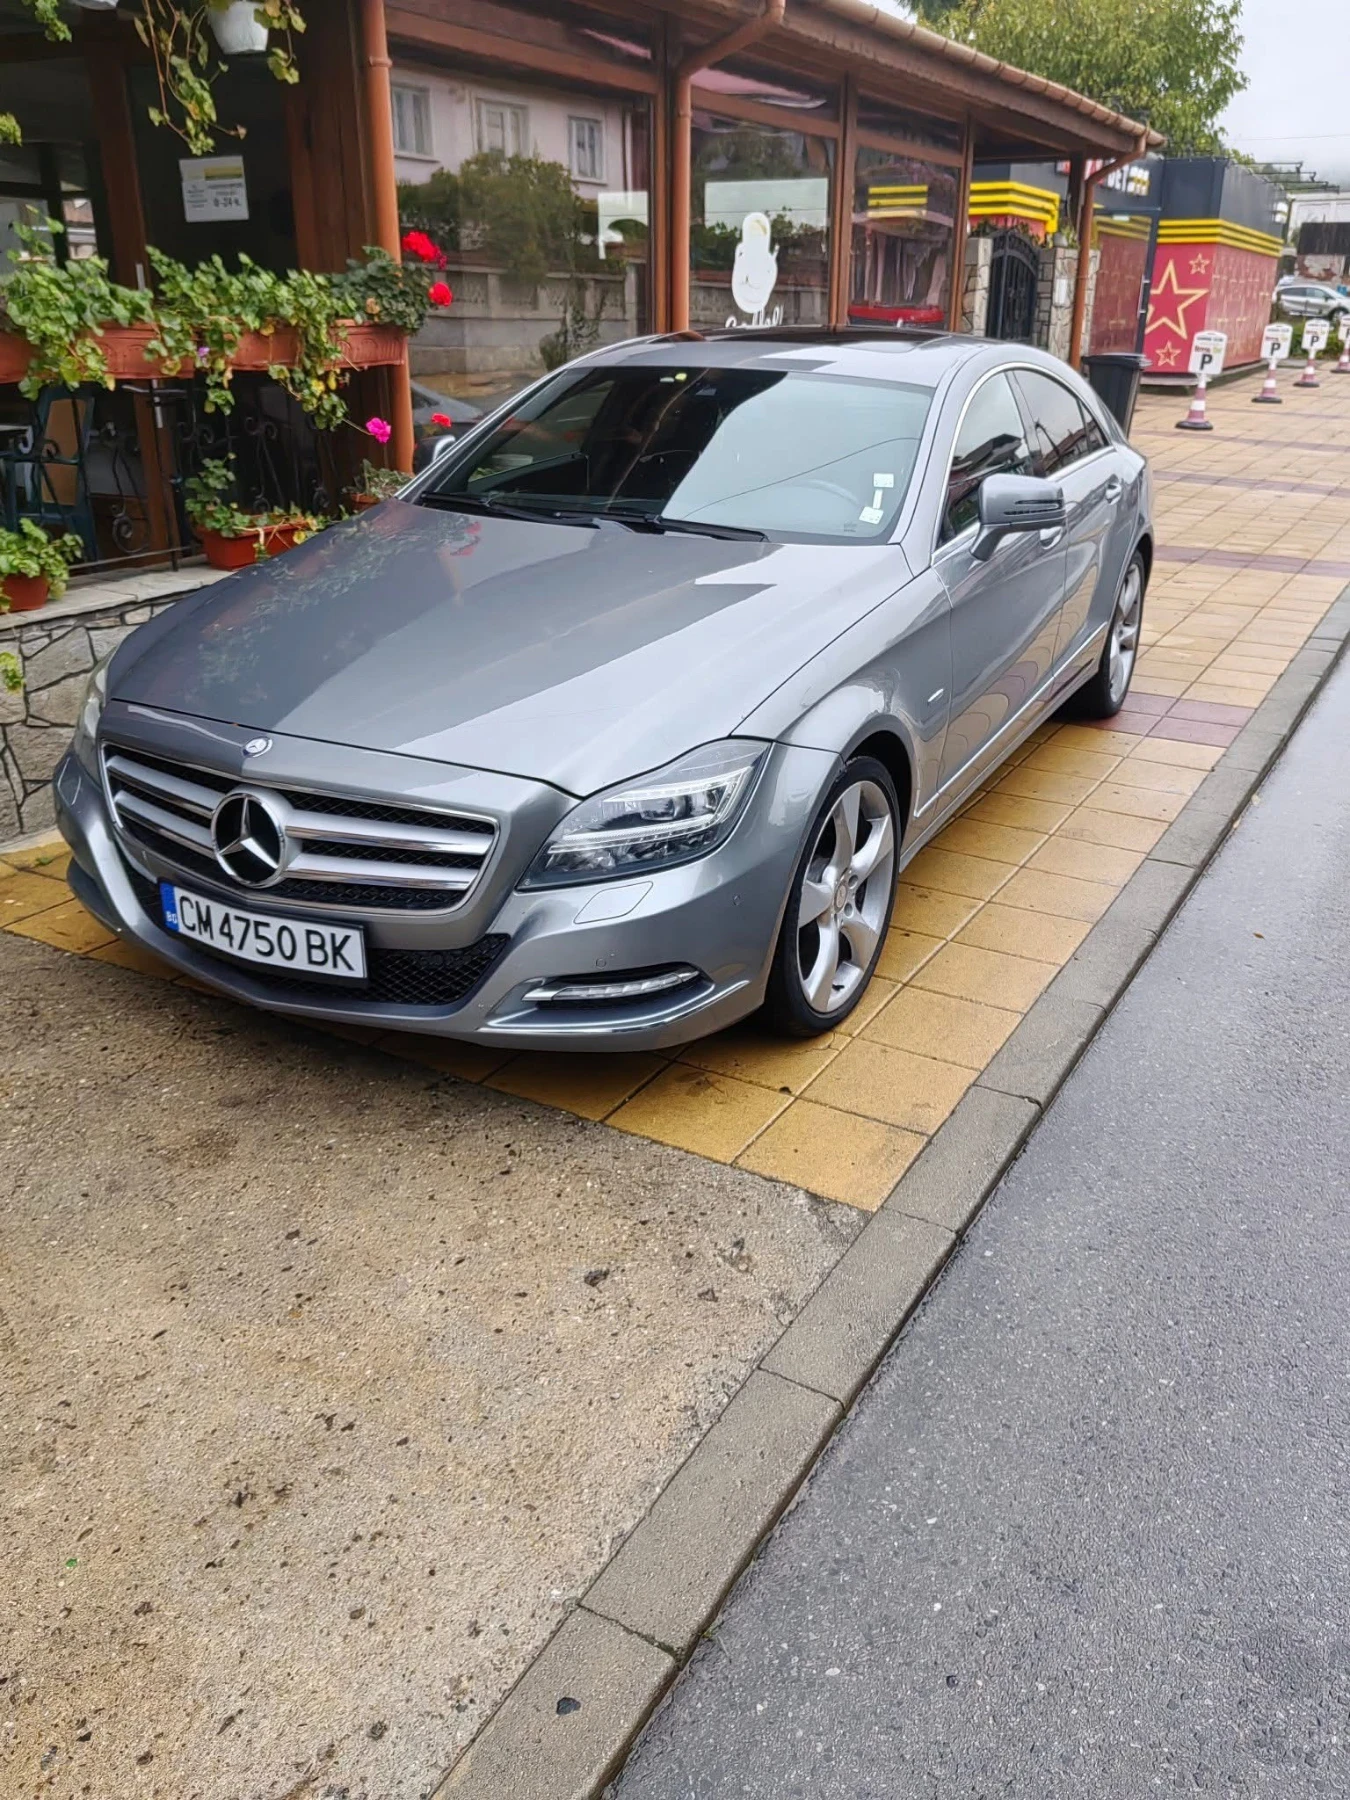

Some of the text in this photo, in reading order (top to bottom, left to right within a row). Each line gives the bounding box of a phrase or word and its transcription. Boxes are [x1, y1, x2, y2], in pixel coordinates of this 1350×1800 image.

[1310, 335, 1319, 347] P
[1270, 342, 1281, 356] P
[1200, 354, 1213, 370] P
